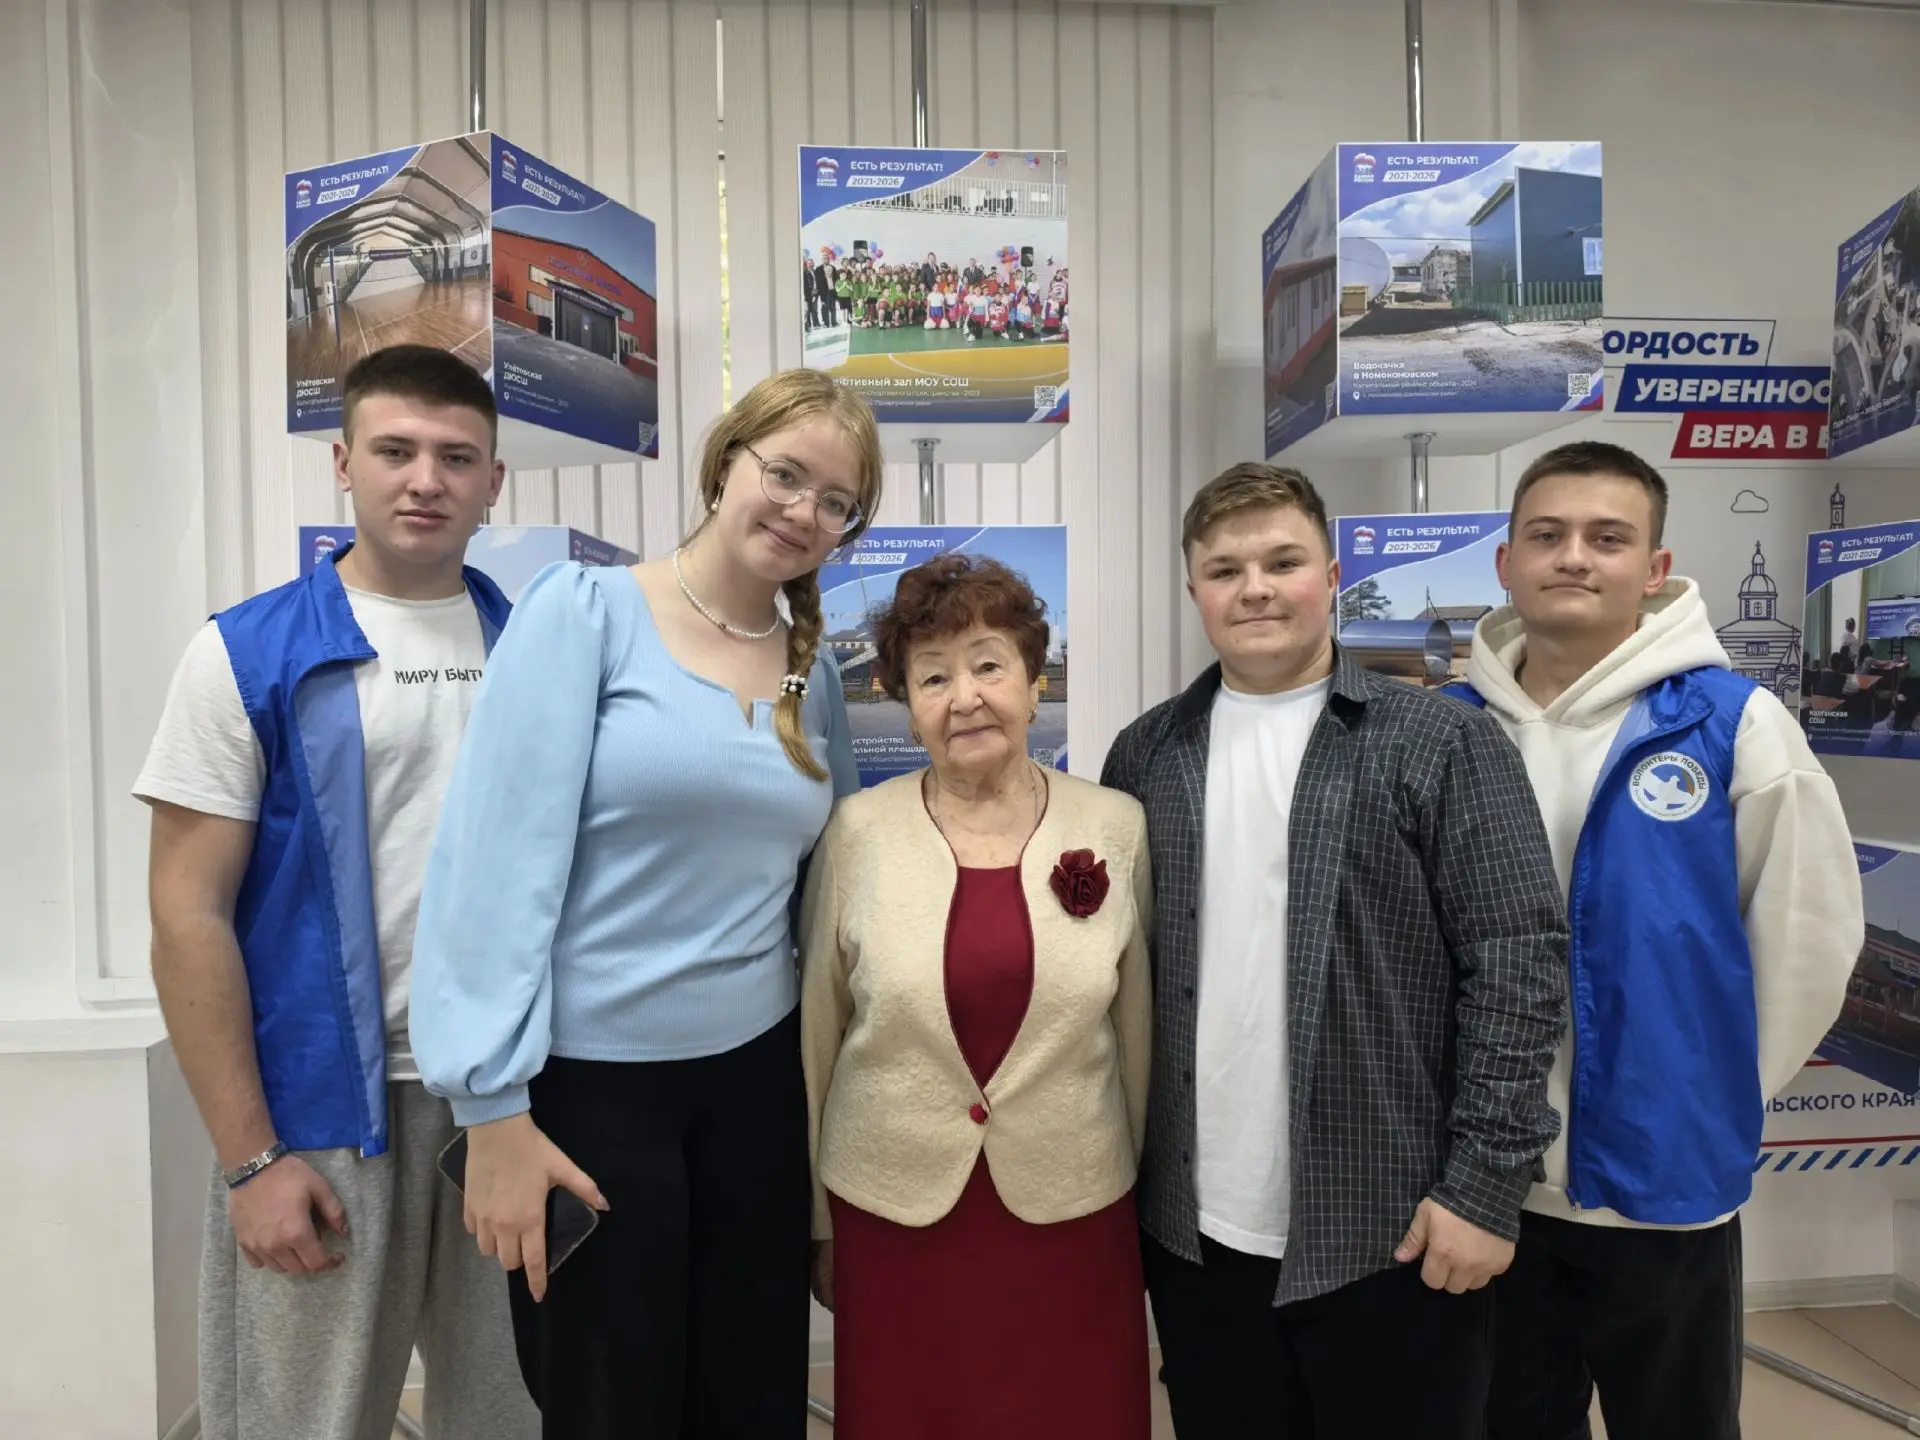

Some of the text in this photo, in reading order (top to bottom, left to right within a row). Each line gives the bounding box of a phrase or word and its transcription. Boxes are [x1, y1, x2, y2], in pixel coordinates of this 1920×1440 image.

[1387, 155, 1479, 166] ЕСТЬ РЕЗУЛЬТАТ!
[850, 161, 944, 172] ЕСТЬ РЕЗУЛЬТАТ!
[320, 165, 389, 187] ЕСТЬ РЕЗУЛЬТАТ!
[524, 164, 543, 181] ЕСТЬ
[1388, 171, 1436, 180] 2021-2026
[852, 177, 900, 187] 2021-2026
[320, 187, 356, 202] 2021-2026
[1353, 361, 1405, 371] Водокачка
[893, 378, 912, 387] зал
[915, 377, 939, 387] МОУ
[942, 377, 969, 387] СОШ
[1689, 424, 1775, 449] ВЕРА
[1785, 425, 1808, 449] В
[1387, 525, 1480, 537] ЕСТЬ РЕЗУЛЬТАТ!
[854, 538, 946, 549] ЕСТЬ РЕЗУЛЬТАТ!
[1842, 532, 1914, 548] ЕСТЬ РЕЗУЛЬТАТ!
[1388, 542, 1436, 552] 2021-2026
[855, 554, 902, 563] 2021-2026
[394, 669, 438, 684] МИРУ
[1632, 754, 1706, 790] ВОЛОНТЕРЫ ПОБЕДЫ
[1862, 1092, 1916, 1108] КРАЯ
